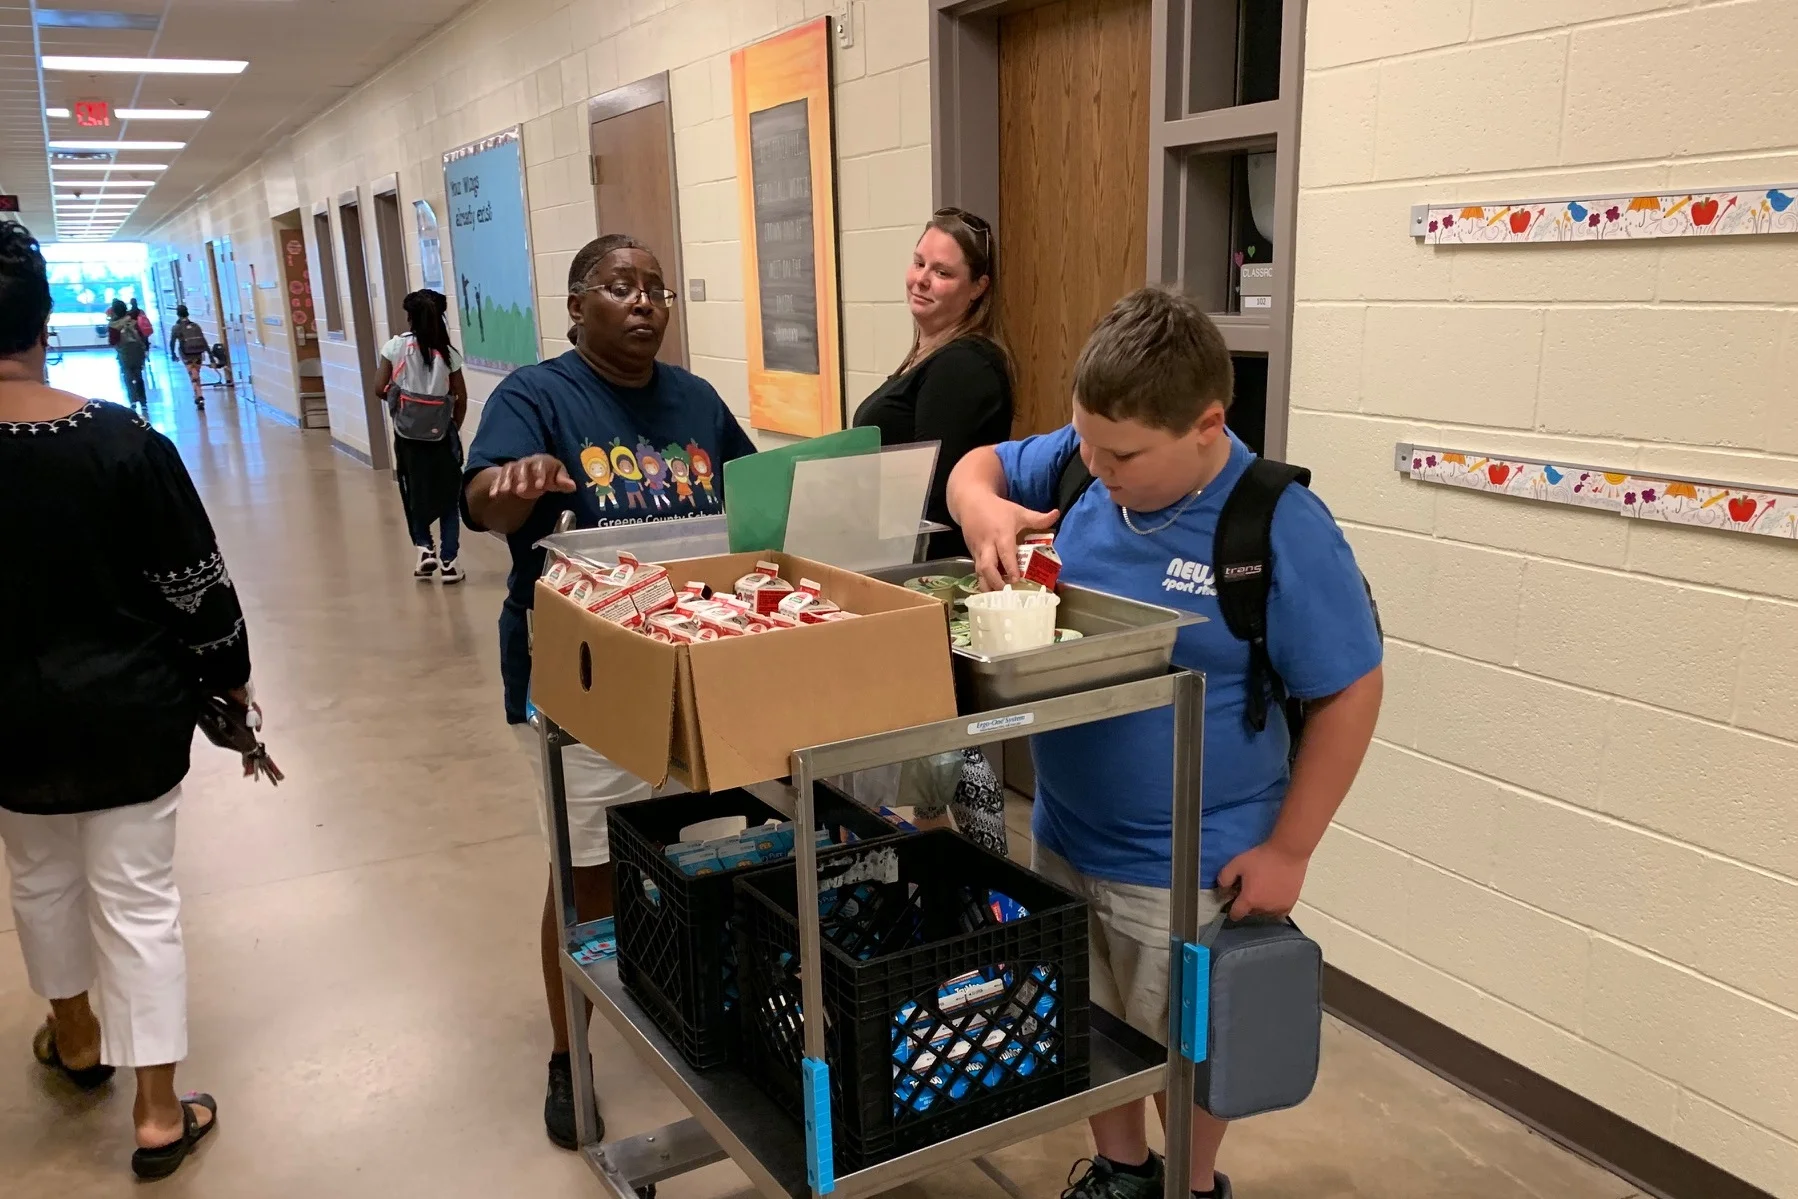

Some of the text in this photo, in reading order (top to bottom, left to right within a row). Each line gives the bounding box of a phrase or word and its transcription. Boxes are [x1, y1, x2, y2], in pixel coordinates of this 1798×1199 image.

[597, 517, 643, 528] Greene
[1225, 564, 1262, 575] trans
[1162, 578, 1195, 592] sport
